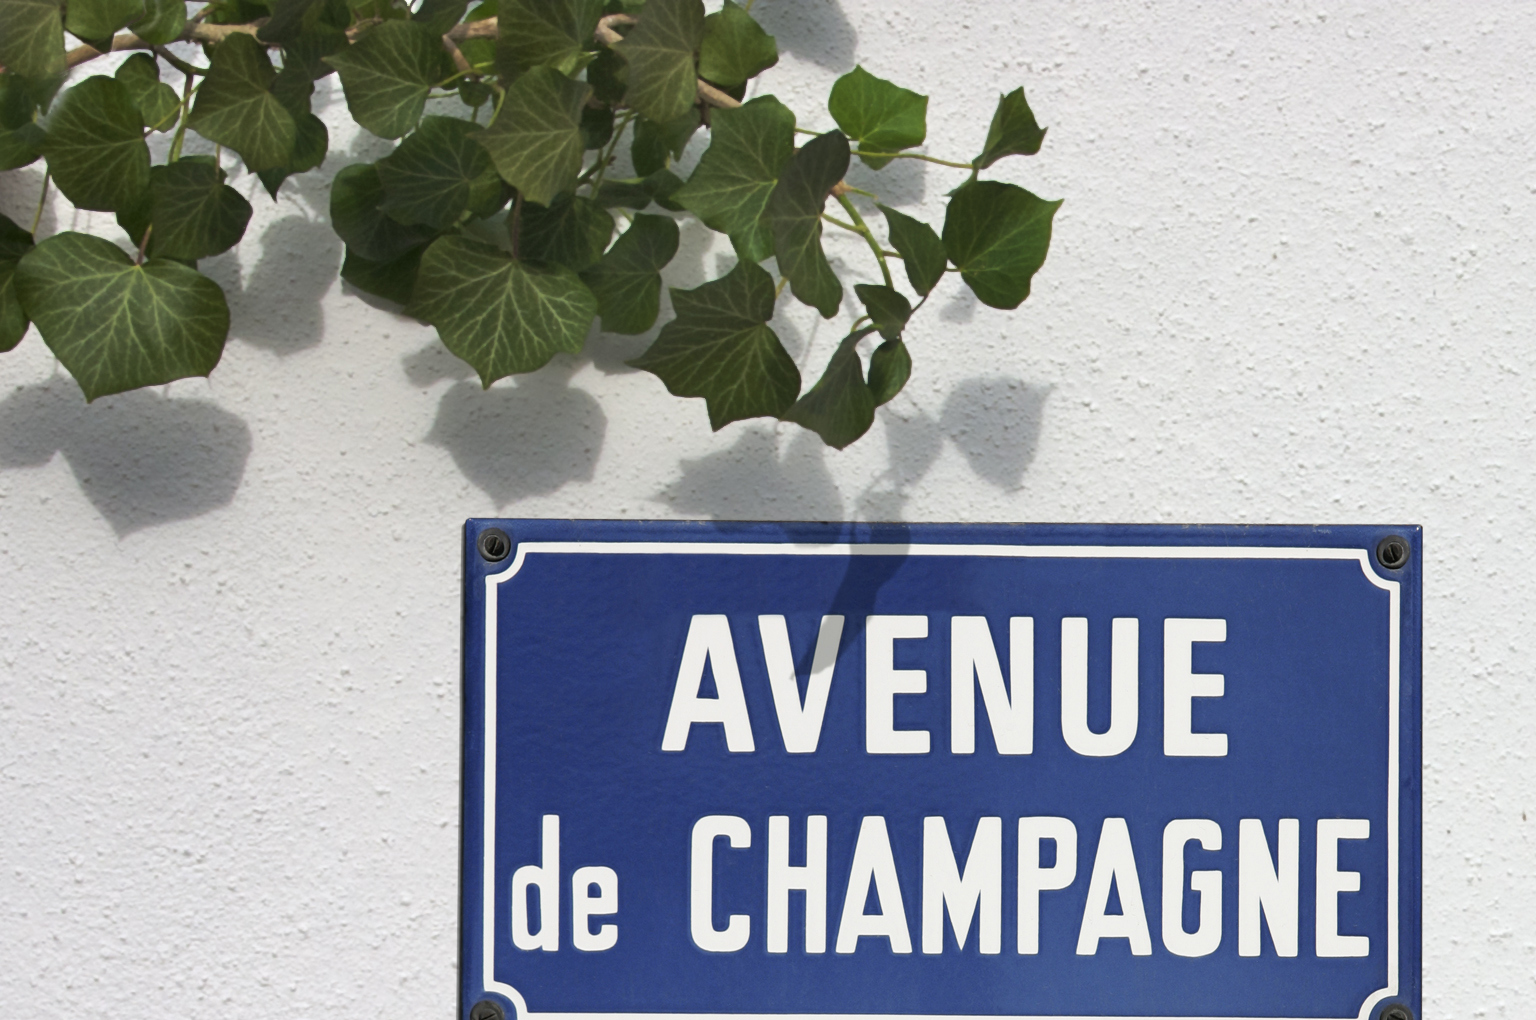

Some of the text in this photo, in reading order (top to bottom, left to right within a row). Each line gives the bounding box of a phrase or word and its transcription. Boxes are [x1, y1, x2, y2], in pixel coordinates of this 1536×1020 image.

[662, 614, 1229, 757] AVENUE
[511, 814, 1371, 958] de CHAMPAGNE
